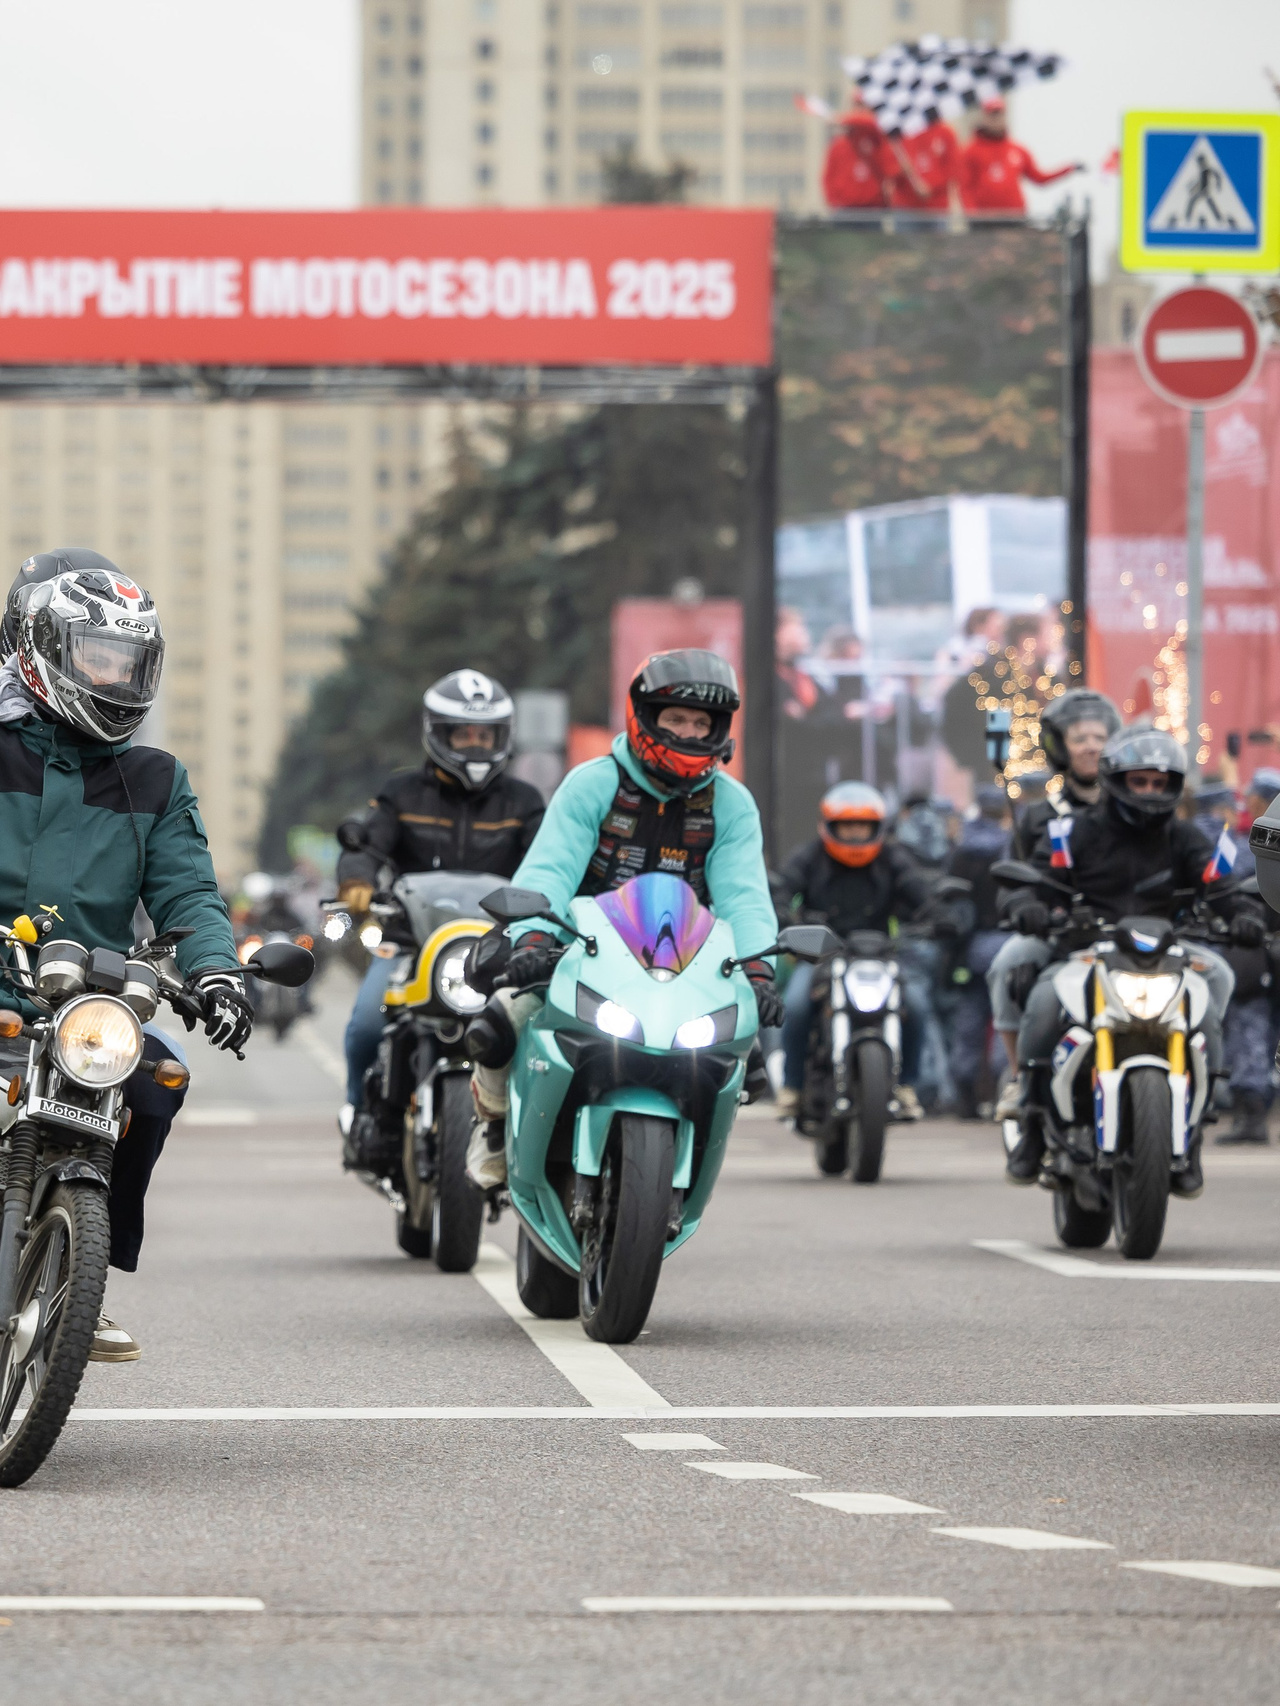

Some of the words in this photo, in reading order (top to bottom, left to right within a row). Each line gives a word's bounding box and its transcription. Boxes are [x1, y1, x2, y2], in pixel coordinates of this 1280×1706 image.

[250, 257, 598, 318] МОТОСЕЗОНА
[606, 258, 736, 319] 2025
[121, 620, 145, 631] HJC
[65, 688, 76, 698] OUT
[42, 1101, 110, 1130] MotoLand
